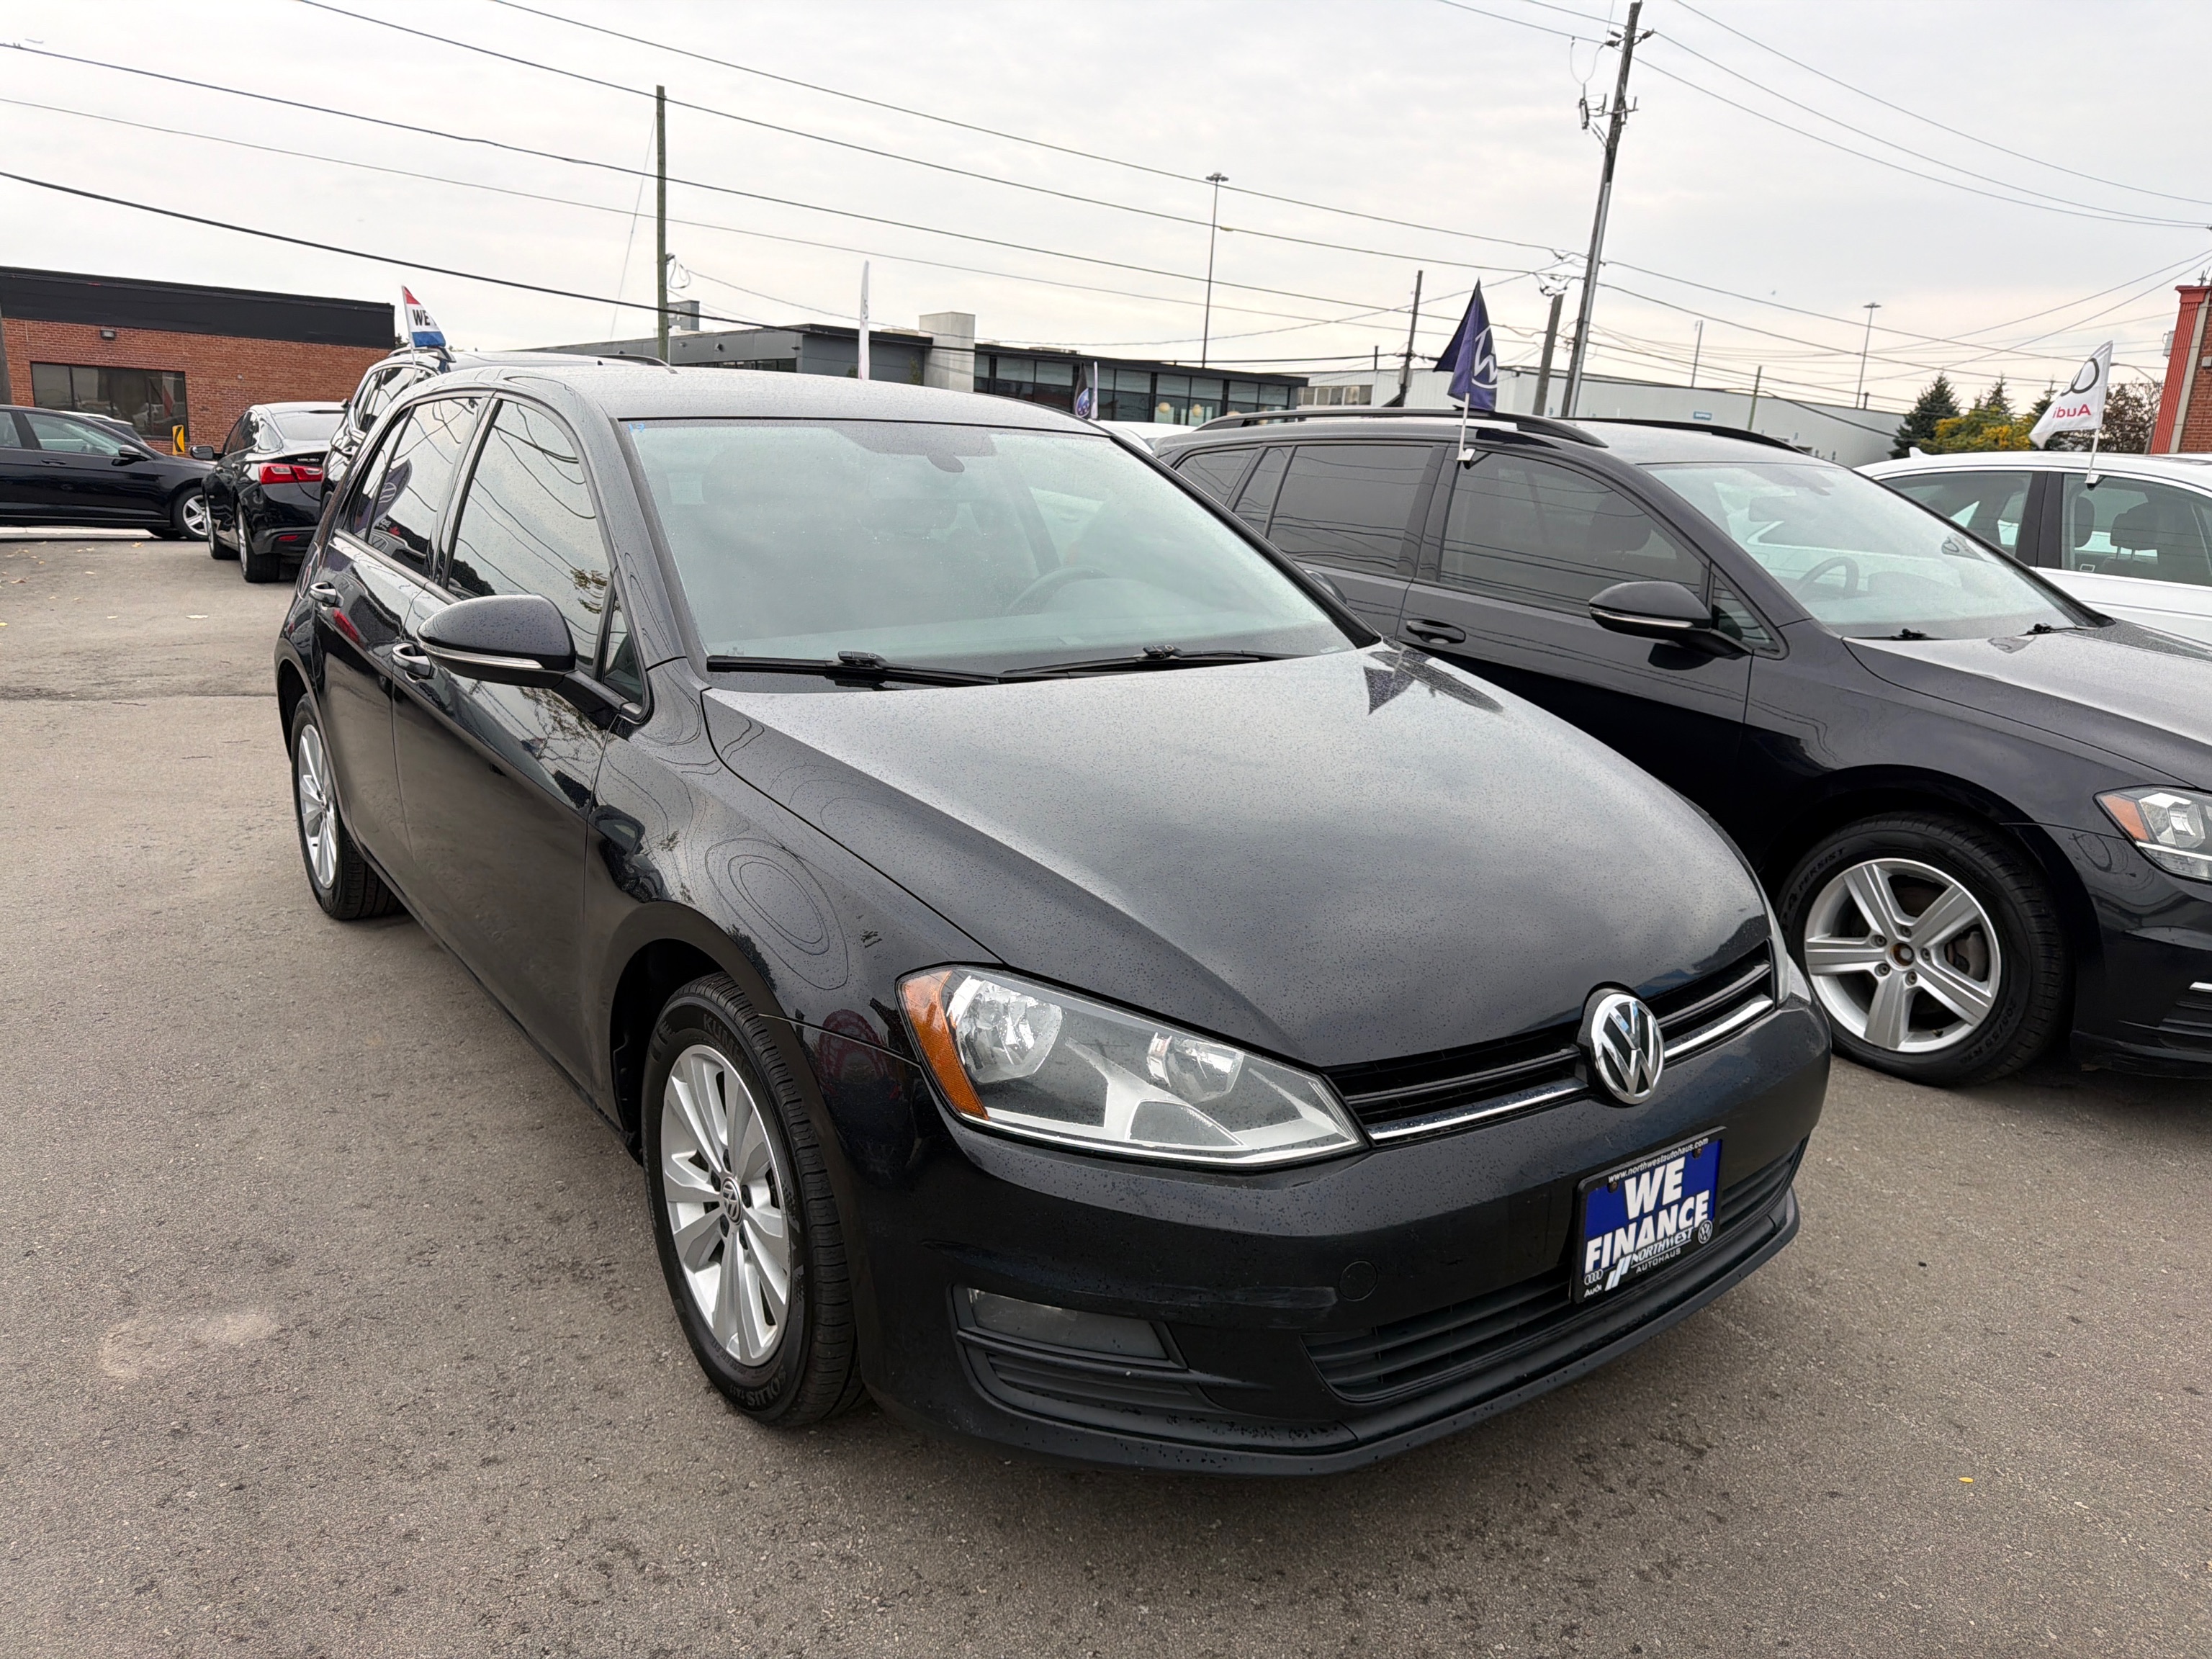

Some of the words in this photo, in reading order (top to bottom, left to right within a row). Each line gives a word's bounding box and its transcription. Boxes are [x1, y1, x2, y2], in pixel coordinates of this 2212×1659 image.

[412, 309, 431, 326] WE
[1608, 1138, 1709, 1183] www.northwestautohaus.com
[1624, 1156, 1686, 1220] WE
[1584, 1190, 1710, 1274] FINANCE
[1630, 1226, 1694, 1264] NORTHWEST
[1635, 1247, 1682, 1274] AUTOHAUS
[1583, 1283, 1603, 1298] Audi
